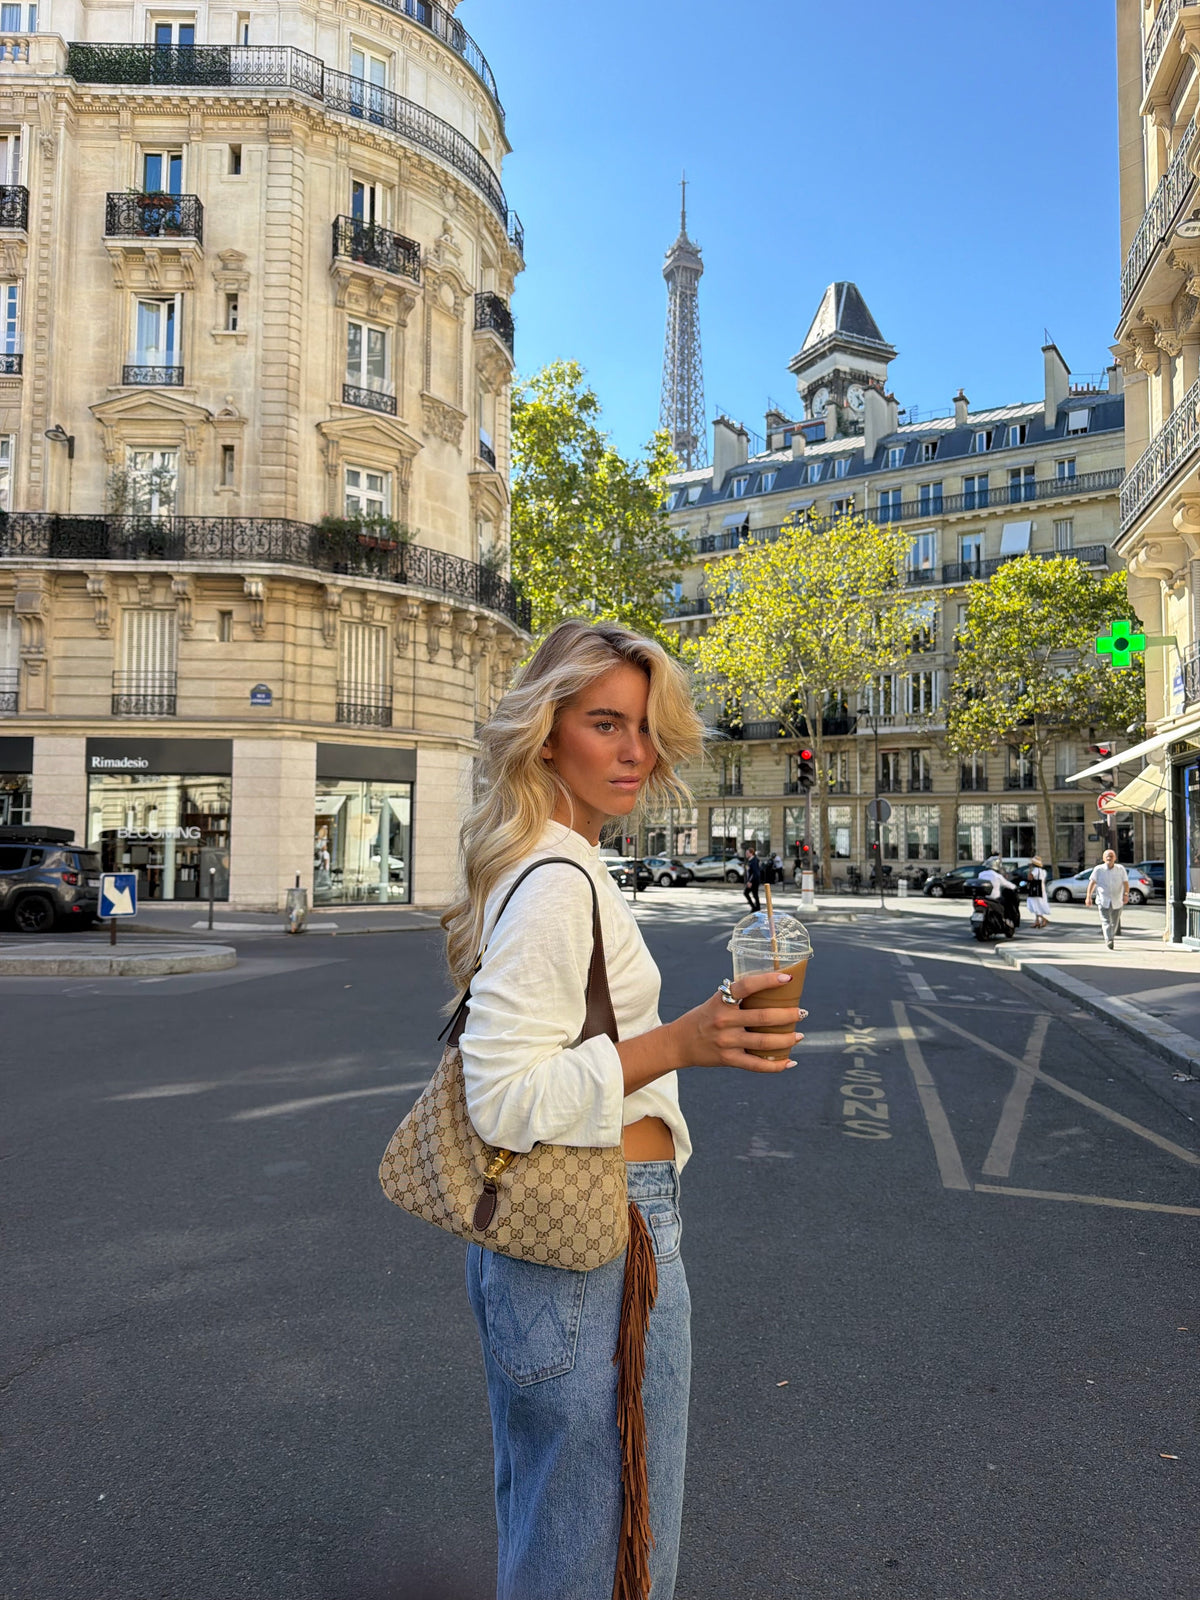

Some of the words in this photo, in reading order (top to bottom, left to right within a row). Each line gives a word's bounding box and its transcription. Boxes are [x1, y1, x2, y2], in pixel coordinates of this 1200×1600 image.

[91, 756, 149, 768] Rimadesio
[117, 826, 201, 839] BECOMING
[839, 1009, 892, 1140] LIVRAISONS
